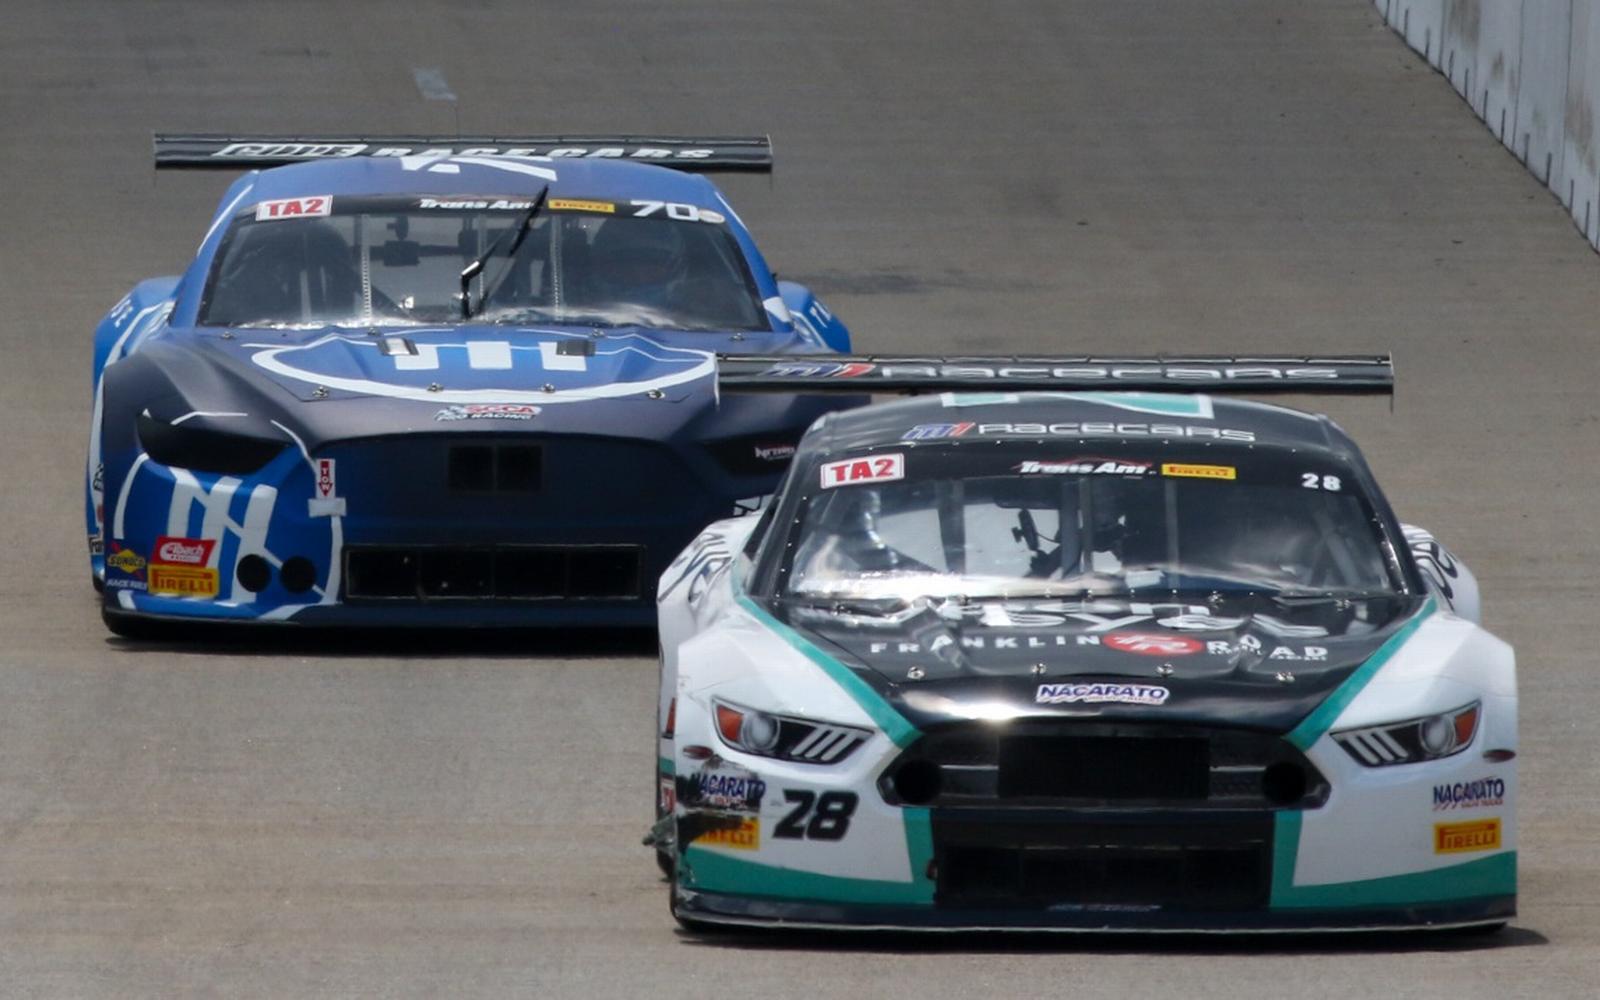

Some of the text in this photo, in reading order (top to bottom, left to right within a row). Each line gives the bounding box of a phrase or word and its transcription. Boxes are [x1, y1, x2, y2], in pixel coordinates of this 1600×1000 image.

[266, 199, 324, 217] TA2
[419, 199, 488, 210] Trans
[630, 199, 699, 222] 70
[830, 458, 895, 482] TA2
[1020, 460, 1148, 474] Trans Am
[1167, 465, 1230, 477] PIRELLI
[320, 467, 331, 491] TOW
[1302, 472, 1342, 492] 28
[151, 568, 214, 593] PIRELLI
[870, 634, 1100, 654] FRANKLIN
[1206, 633, 1329, 659] ROAD
[1040, 685, 1166, 699] NACARATO
[1432, 778, 1505, 804] NACARATO
[772, 788, 860, 841] 28
[1438, 823, 1497, 850] PIRELLI
